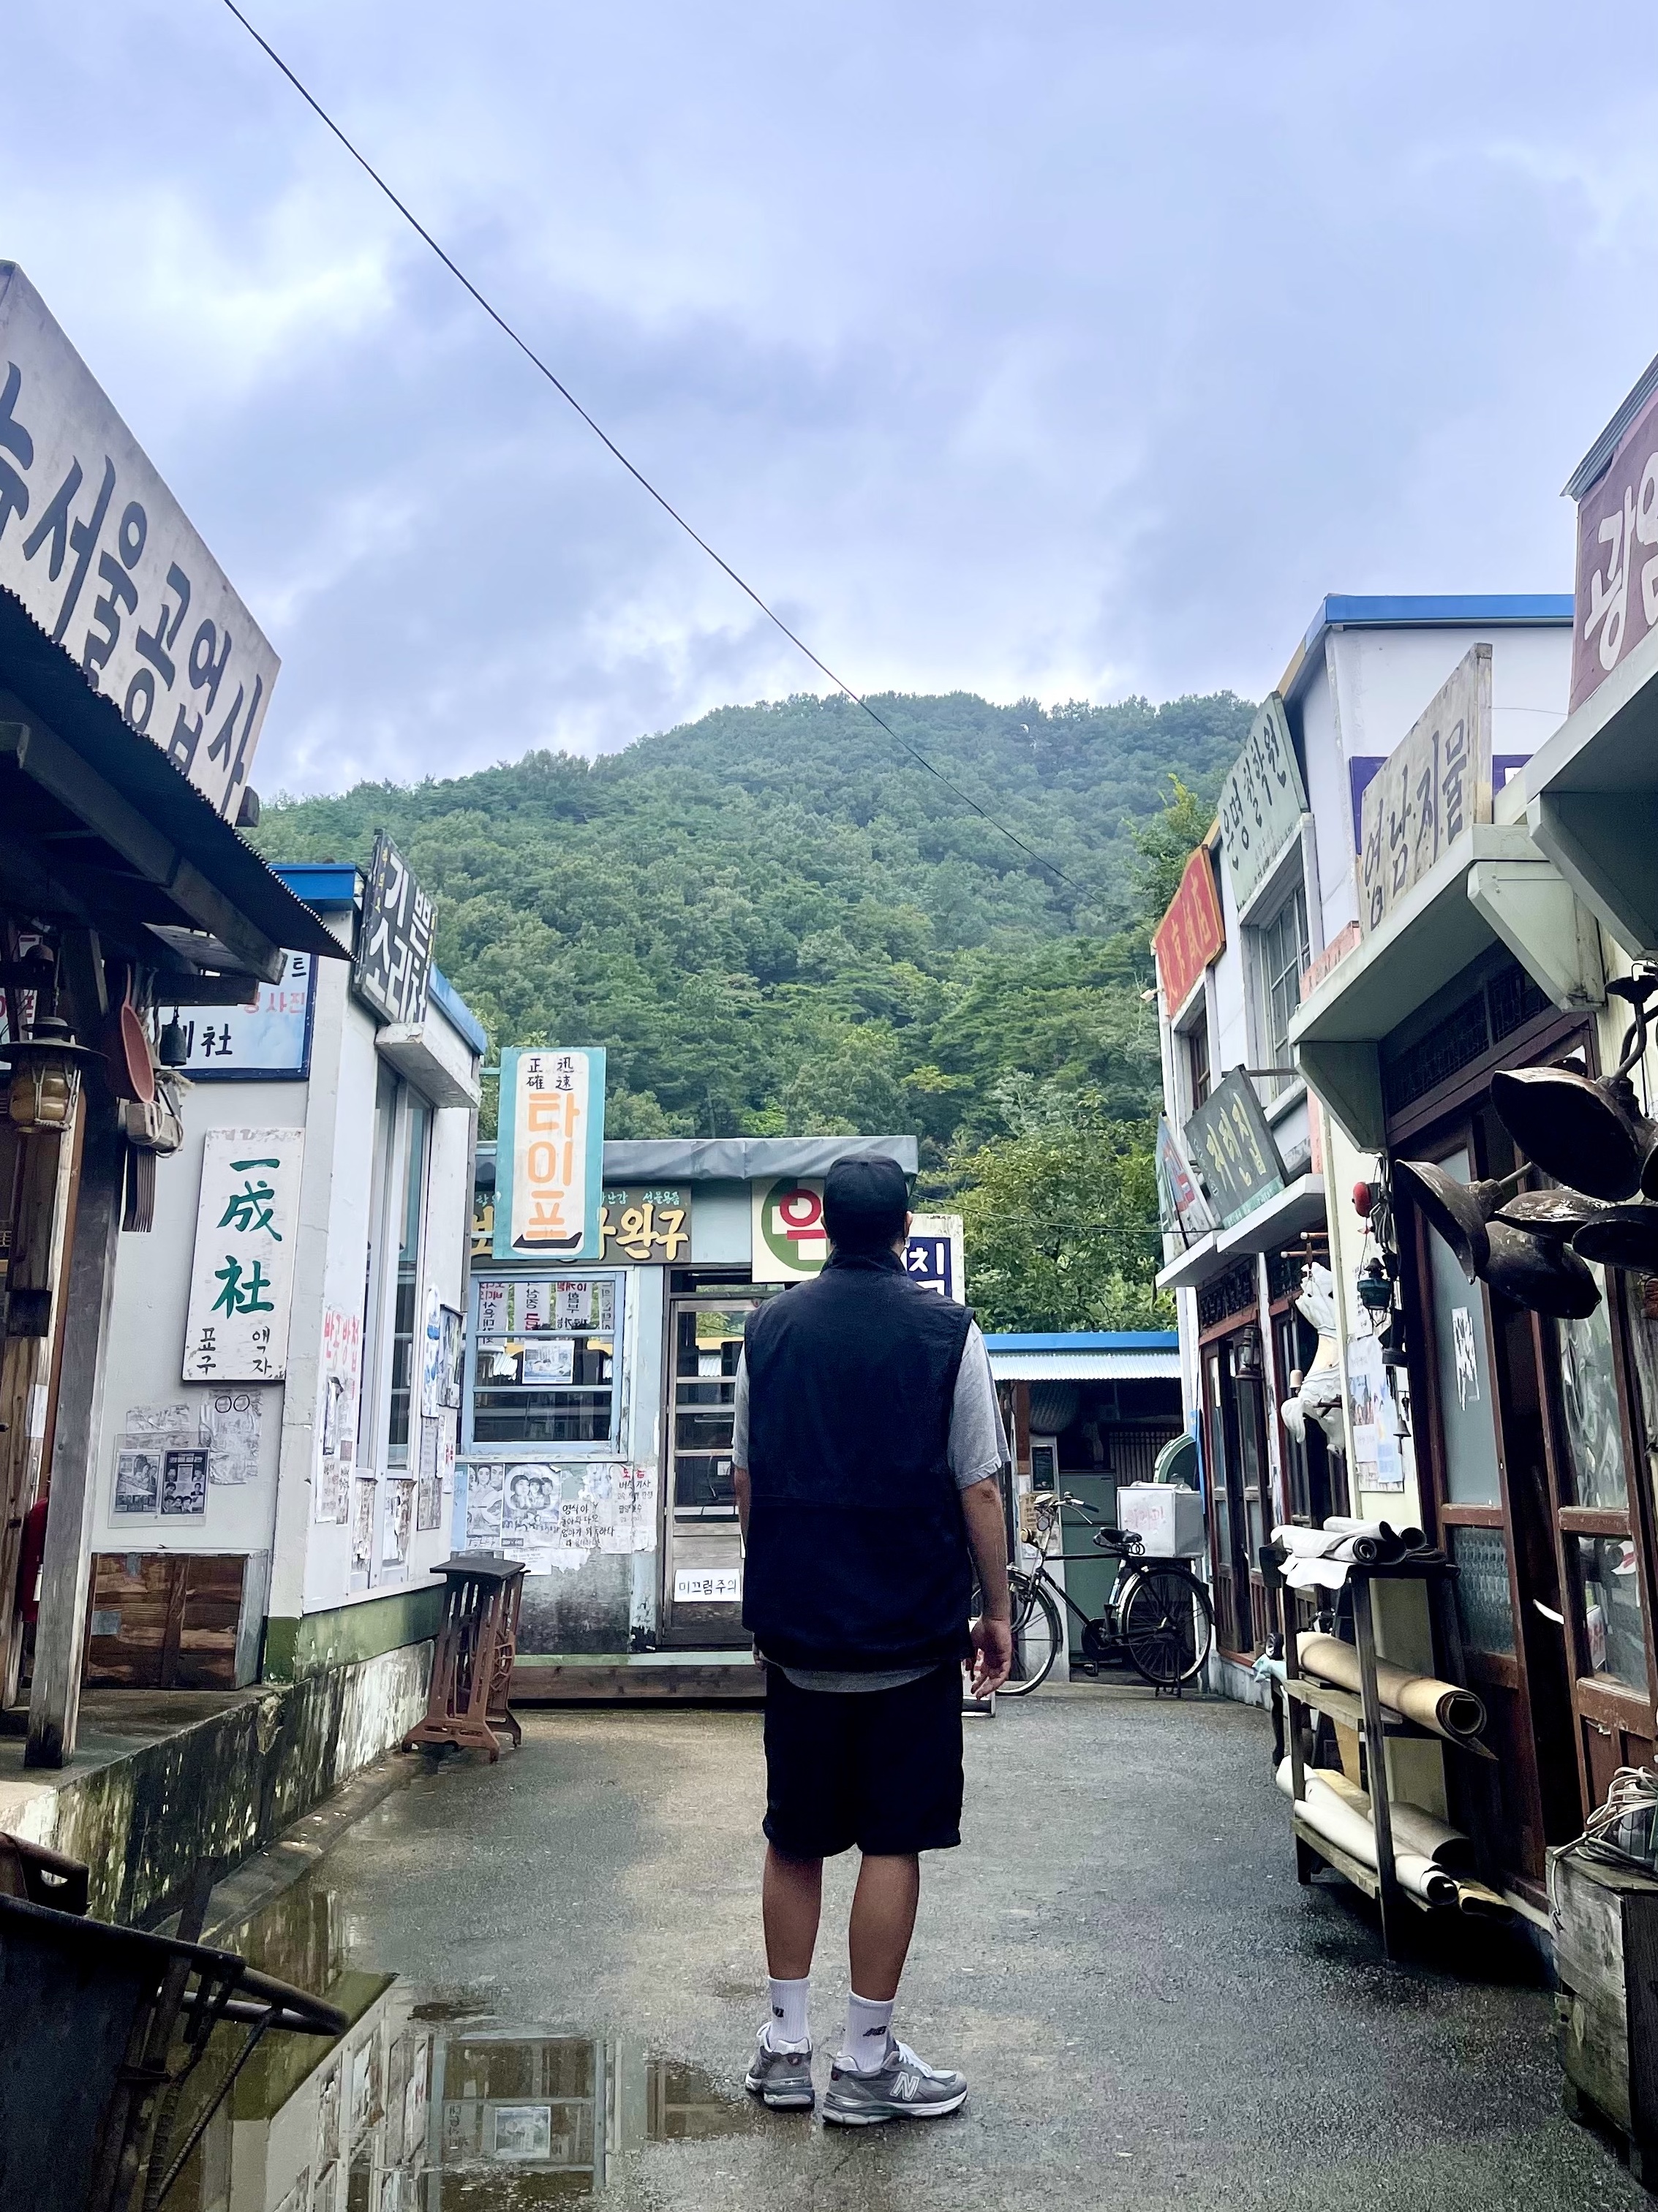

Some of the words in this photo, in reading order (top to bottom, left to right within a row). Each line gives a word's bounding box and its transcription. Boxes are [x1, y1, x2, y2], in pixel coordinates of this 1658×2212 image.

[1222, 713, 1286, 871] 운명철학원
[384, 853, 432, 959] 기쁜
[526, 1092, 580, 1239] 타이프
[211, 1158, 282, 1319] 一成社
[197, 1327, 216, 1376] 표구
[252, 1326, 275, 1373] 액자
